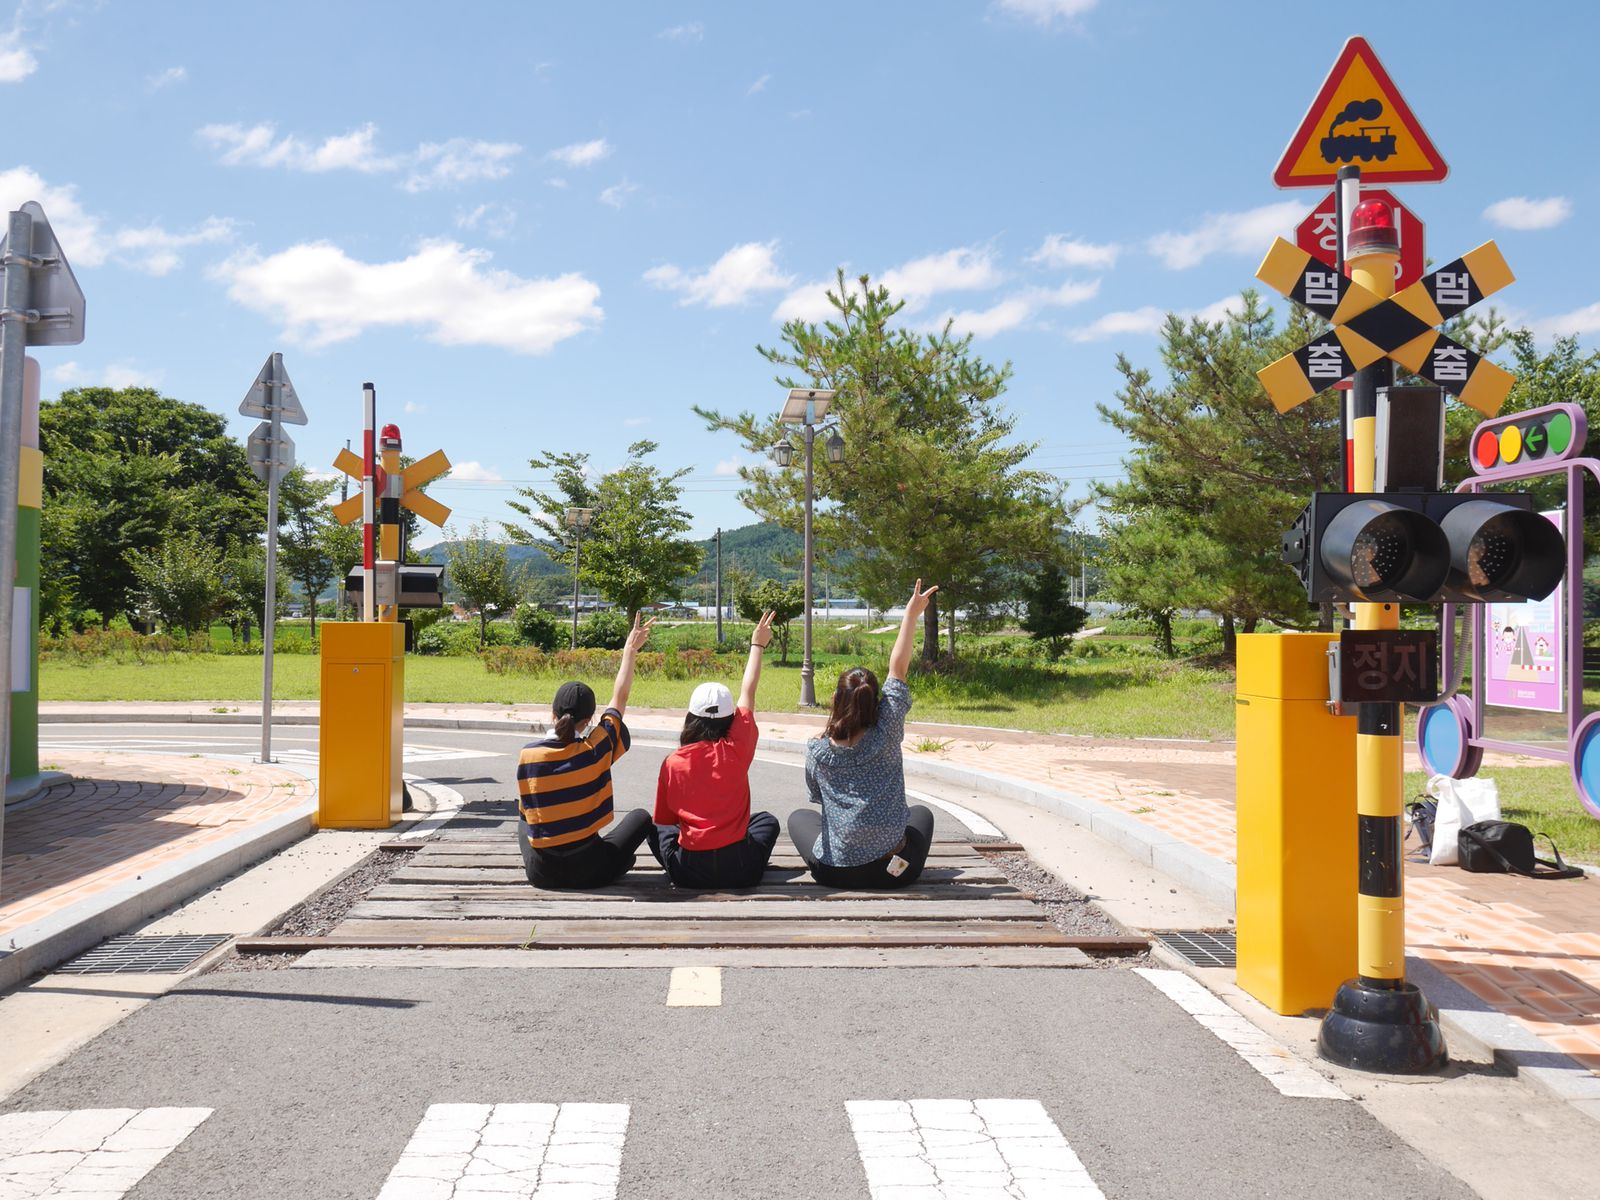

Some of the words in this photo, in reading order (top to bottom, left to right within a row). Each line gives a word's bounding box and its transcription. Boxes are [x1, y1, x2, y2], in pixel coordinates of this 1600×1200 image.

[1305, 271, 1338, 305] 멈
[1435, 272, 1469, 305] 멈
[1308, 342, 1342, 378] 춤
[1433, 345, 1468, 381] 춤
[1353, 640, 1426, 690] 정지
